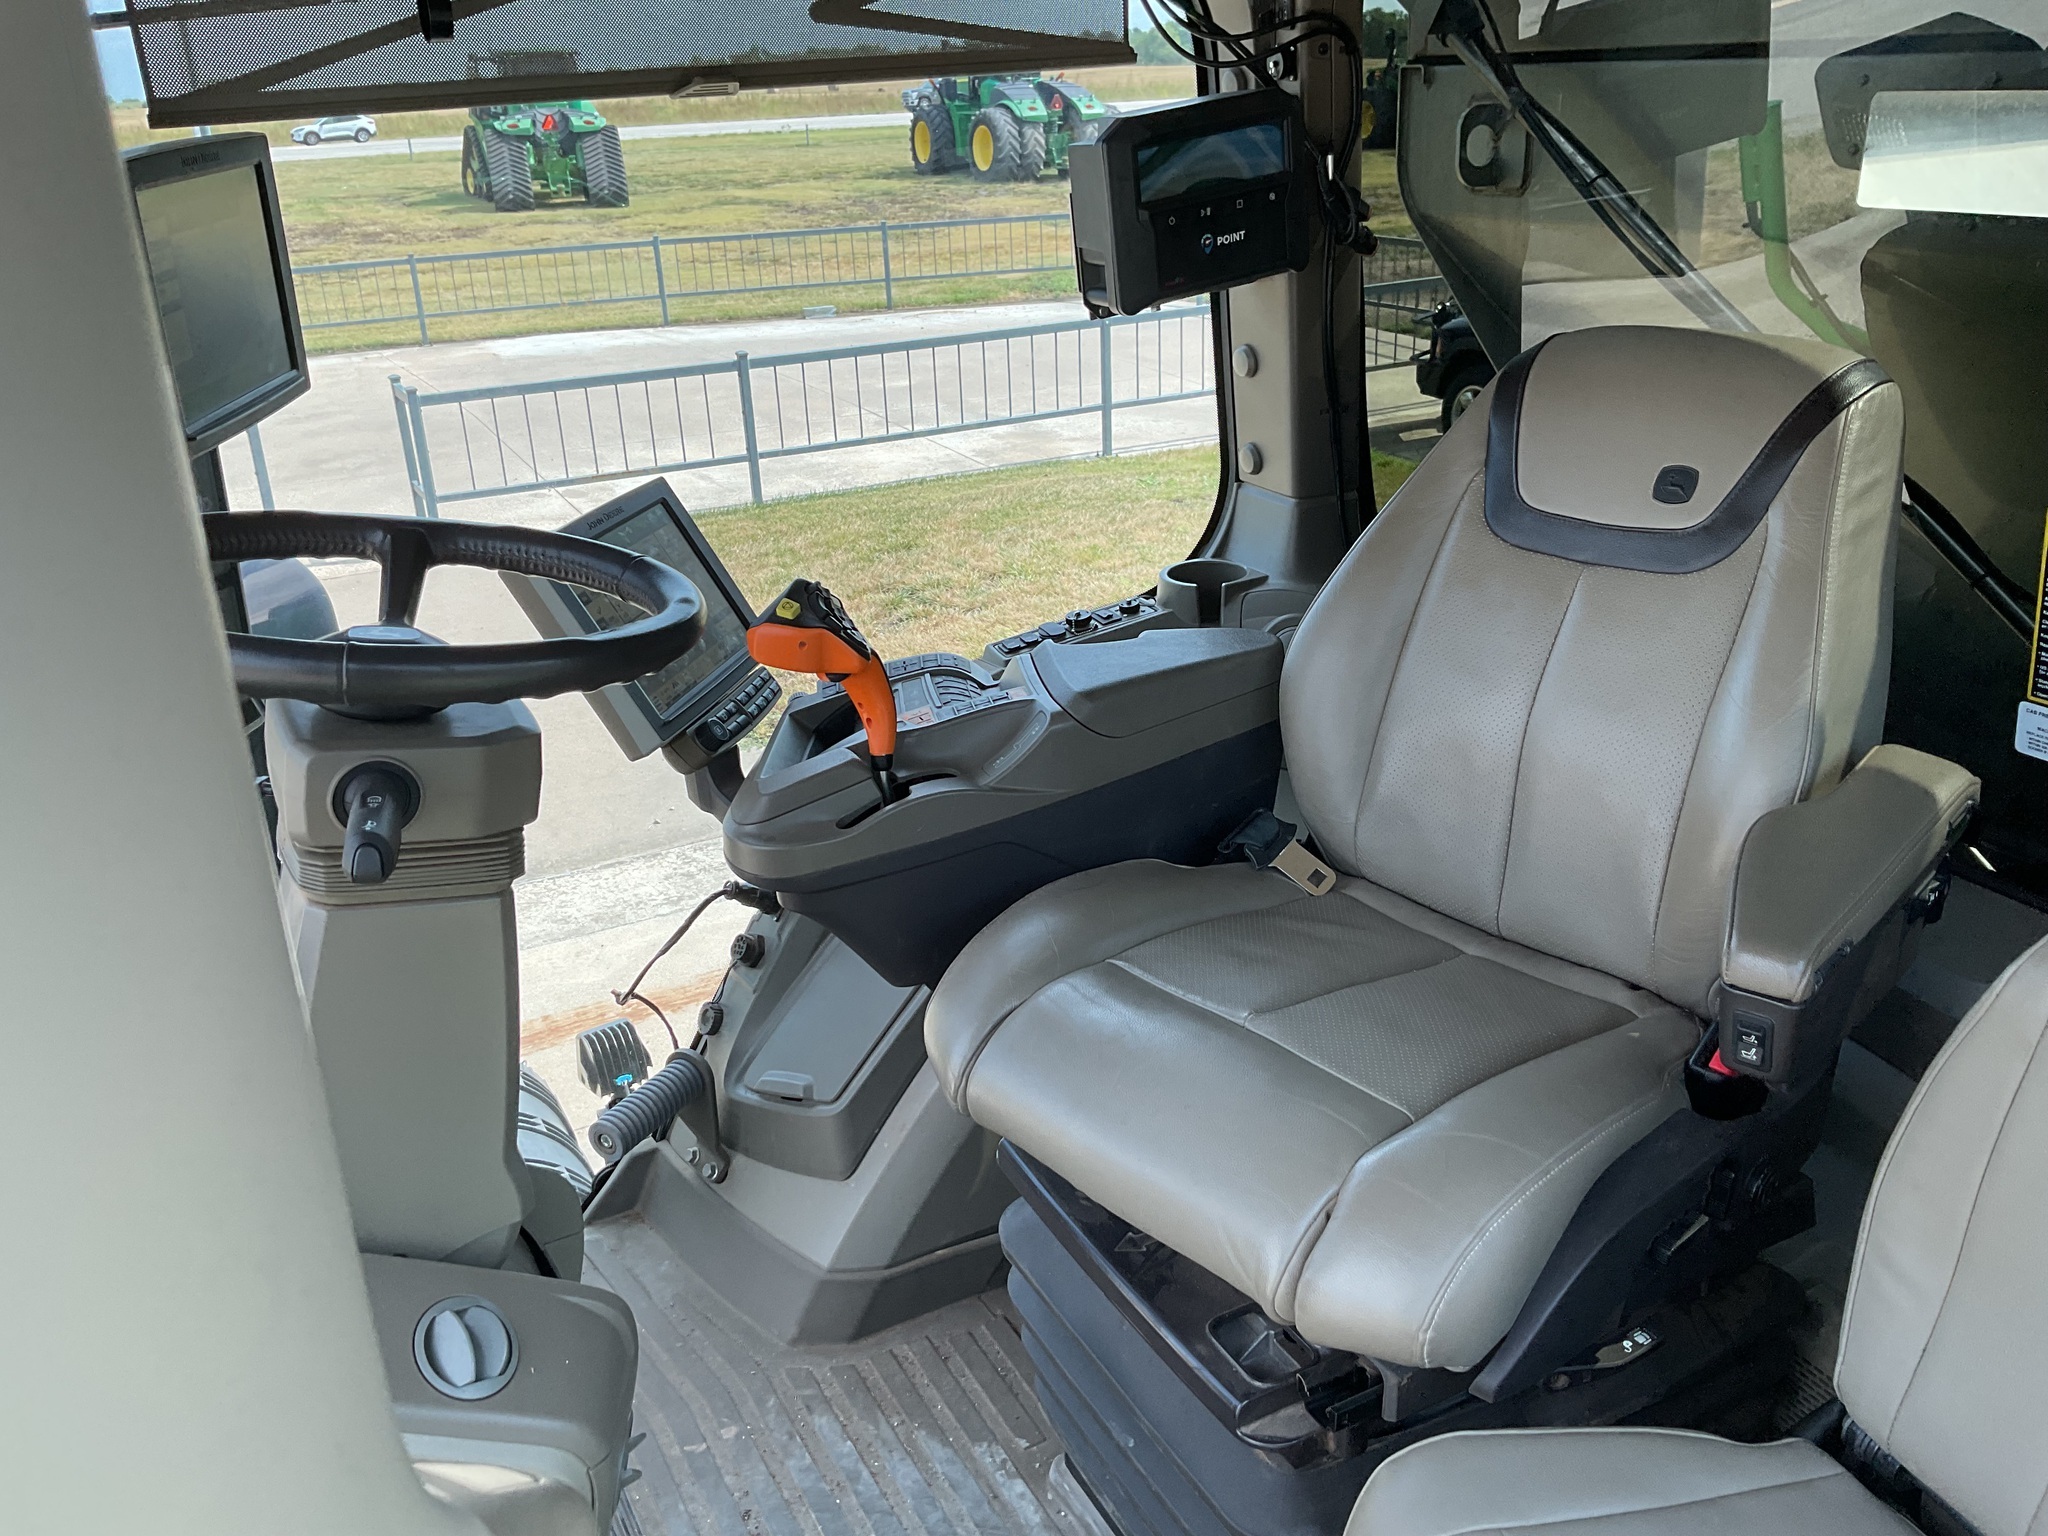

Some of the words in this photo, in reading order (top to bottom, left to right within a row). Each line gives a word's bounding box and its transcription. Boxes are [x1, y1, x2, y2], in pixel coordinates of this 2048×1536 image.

[1216, 230, 1246, 247] POINT
[586, 517, 605, 531] JOHN
[602, 505, 625, 521] DEERE
[2026, 708, 2038, 716] CAB
